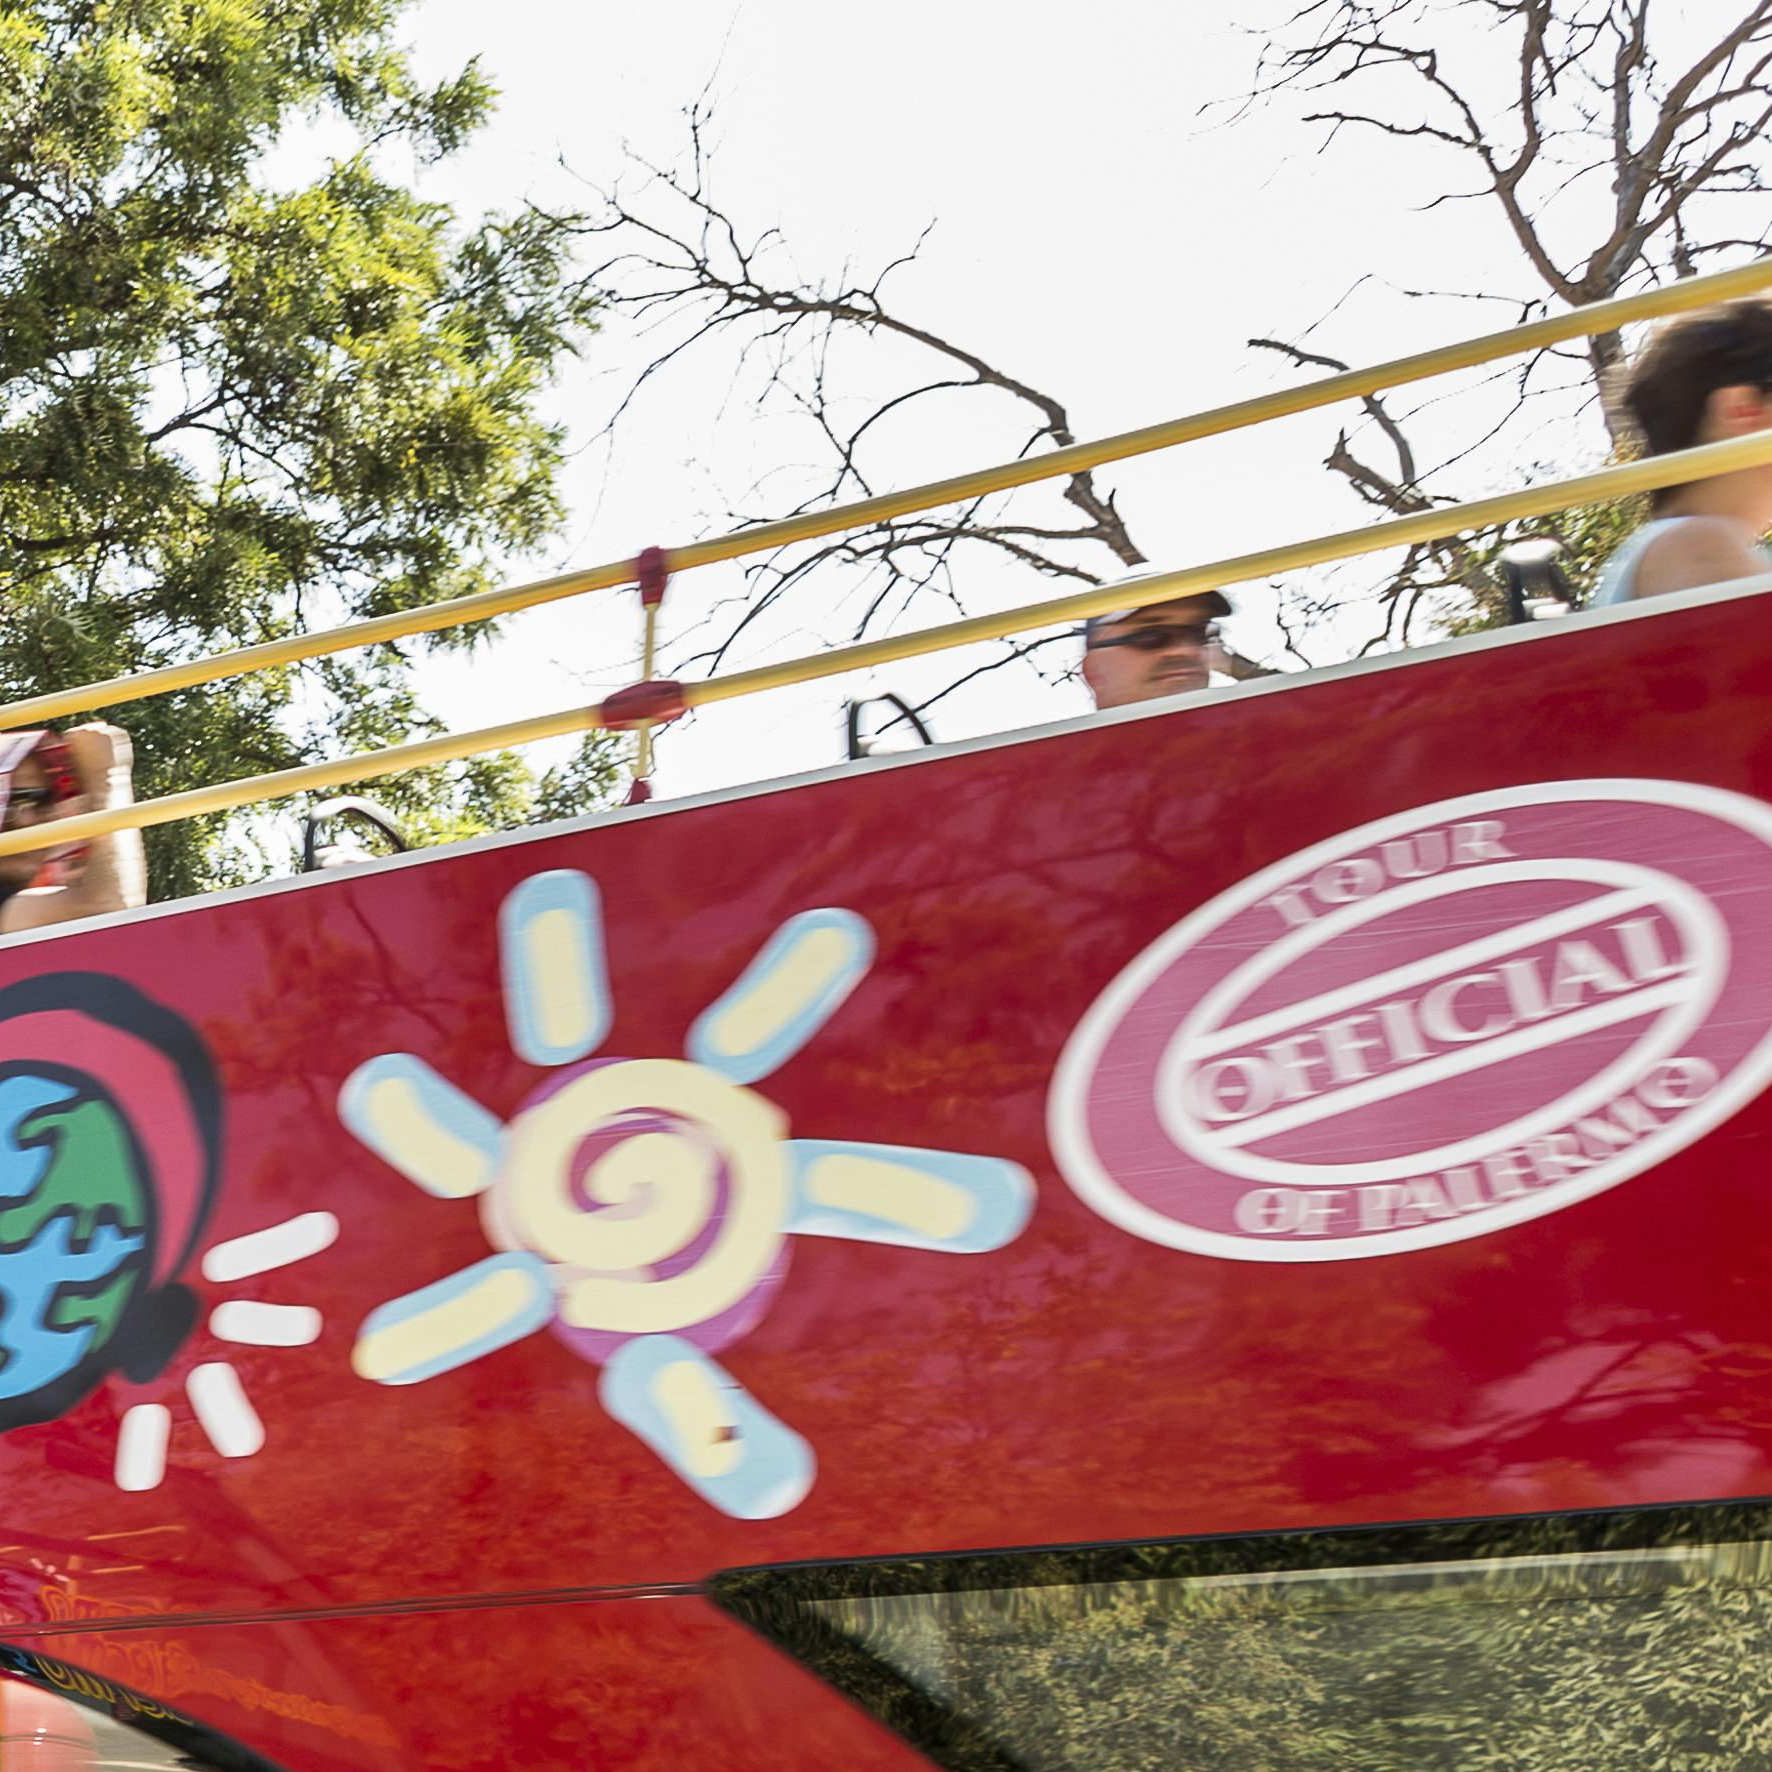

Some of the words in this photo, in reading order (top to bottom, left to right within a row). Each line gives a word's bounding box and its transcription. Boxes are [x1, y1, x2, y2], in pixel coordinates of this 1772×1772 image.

[1259, 819, 1521, 928] TOUR
[1186, 916, 1681, 1122] OFFICIAL
[1234, 1184, 1354, 1236] OF
[1354, 1056, 1719, 1231] PALERMO
